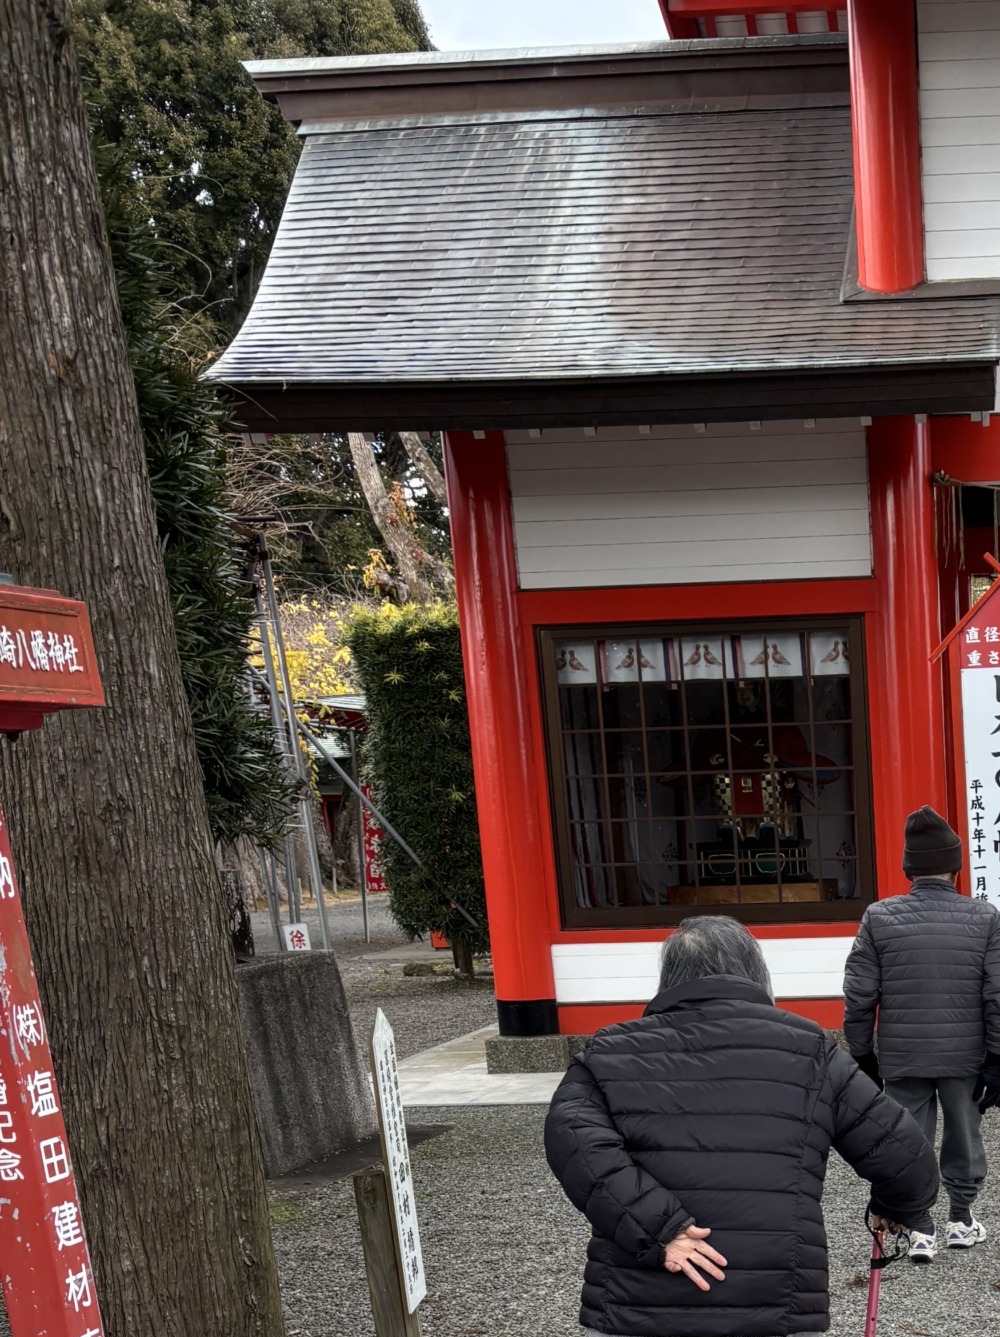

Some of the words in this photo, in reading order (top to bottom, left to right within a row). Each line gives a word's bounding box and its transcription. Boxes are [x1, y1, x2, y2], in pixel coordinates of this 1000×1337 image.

[965, 626, 1000, 644] 直径
[966, 649, 1000, 667] 重さ
[289, 929, 306, 950] 徐
